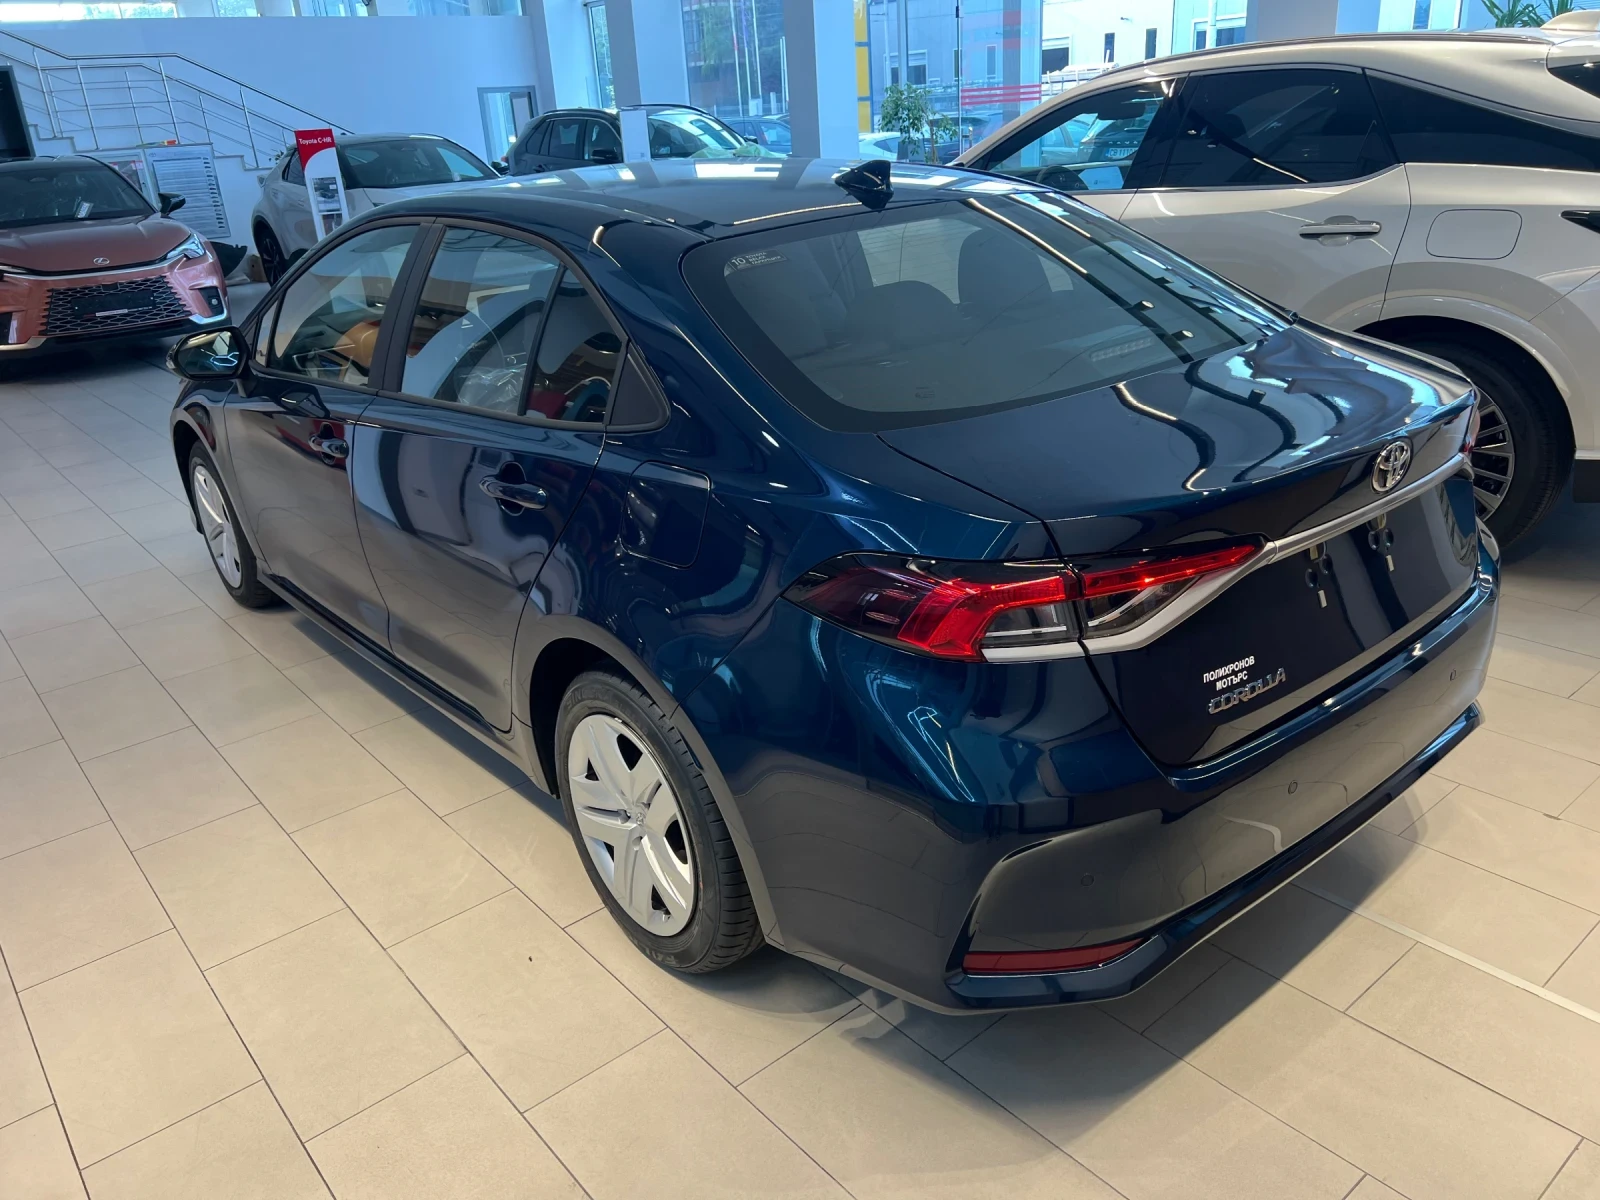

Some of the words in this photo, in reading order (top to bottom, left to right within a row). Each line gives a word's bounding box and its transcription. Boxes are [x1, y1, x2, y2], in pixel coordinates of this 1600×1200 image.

[298, 138, 318, 146] Toyota
[317, 136, 332, 144] C-HR
[731, 257, 746, 266] 10
[1203, 655, 1255, 683] ПОЛИХРОНОВ
[1208, 667, 1286, 714] COROLLA
[1215, 670, 1248, 691] МОТЪРС
